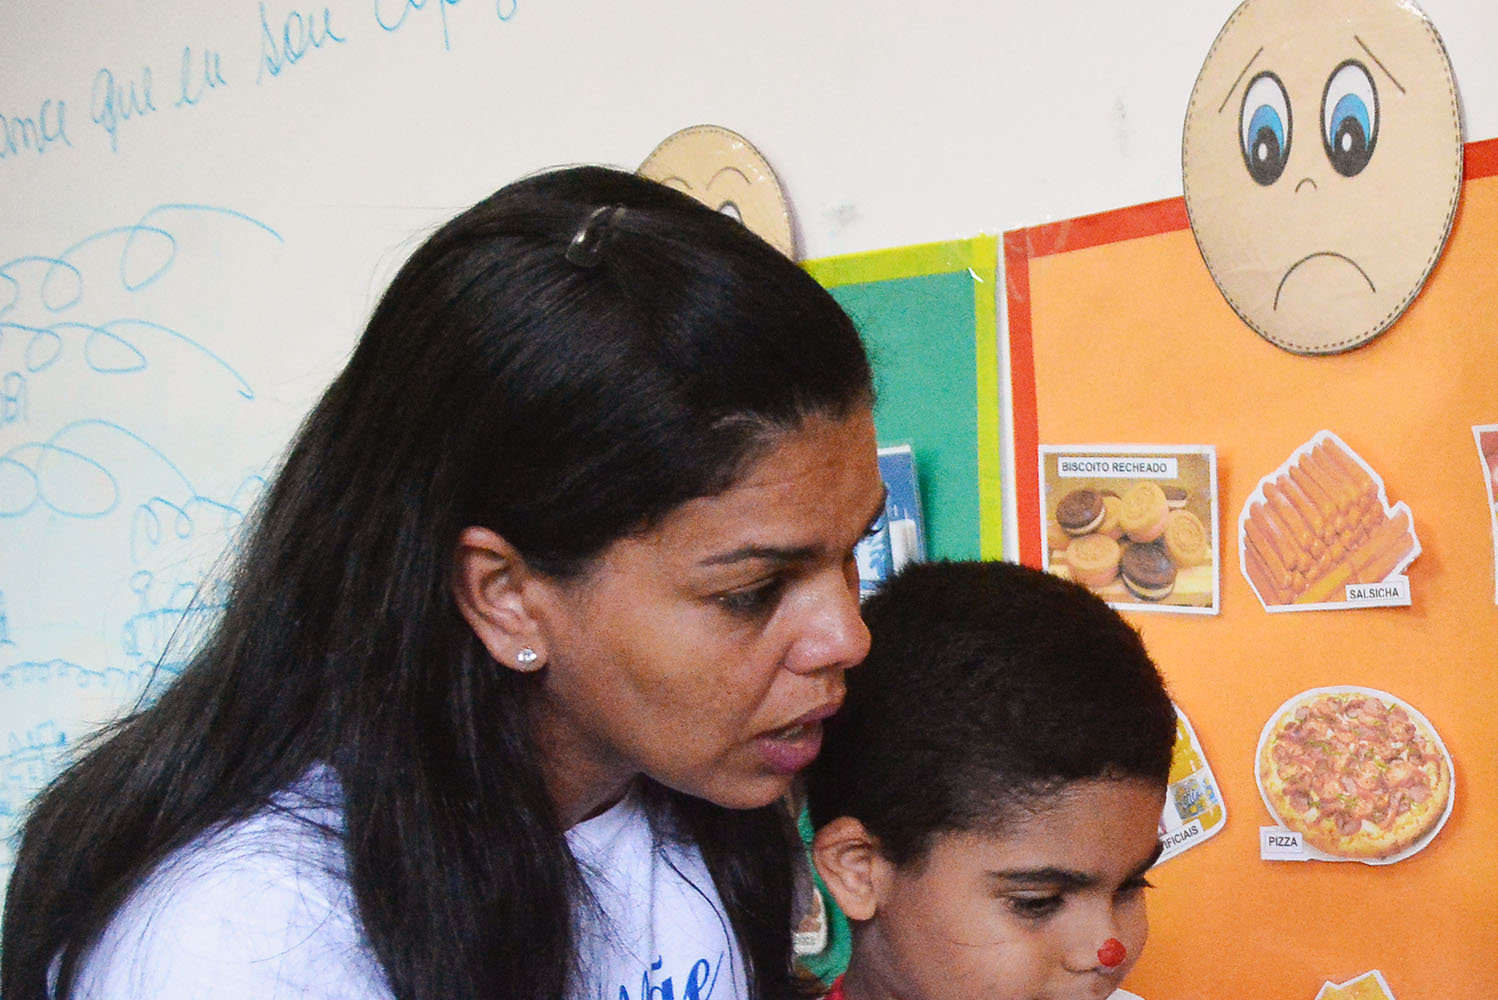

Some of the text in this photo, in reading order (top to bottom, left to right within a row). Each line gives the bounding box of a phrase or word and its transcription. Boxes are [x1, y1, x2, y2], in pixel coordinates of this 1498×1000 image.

[1061, 461, 1168, 474] BISCOITO RECHEADO
[1349, 586, 1400, 600] SALSICHA
[1162, 825, 1199, 849] IFICIAIS
[1268, 835, 1299, 848] PIZZA
